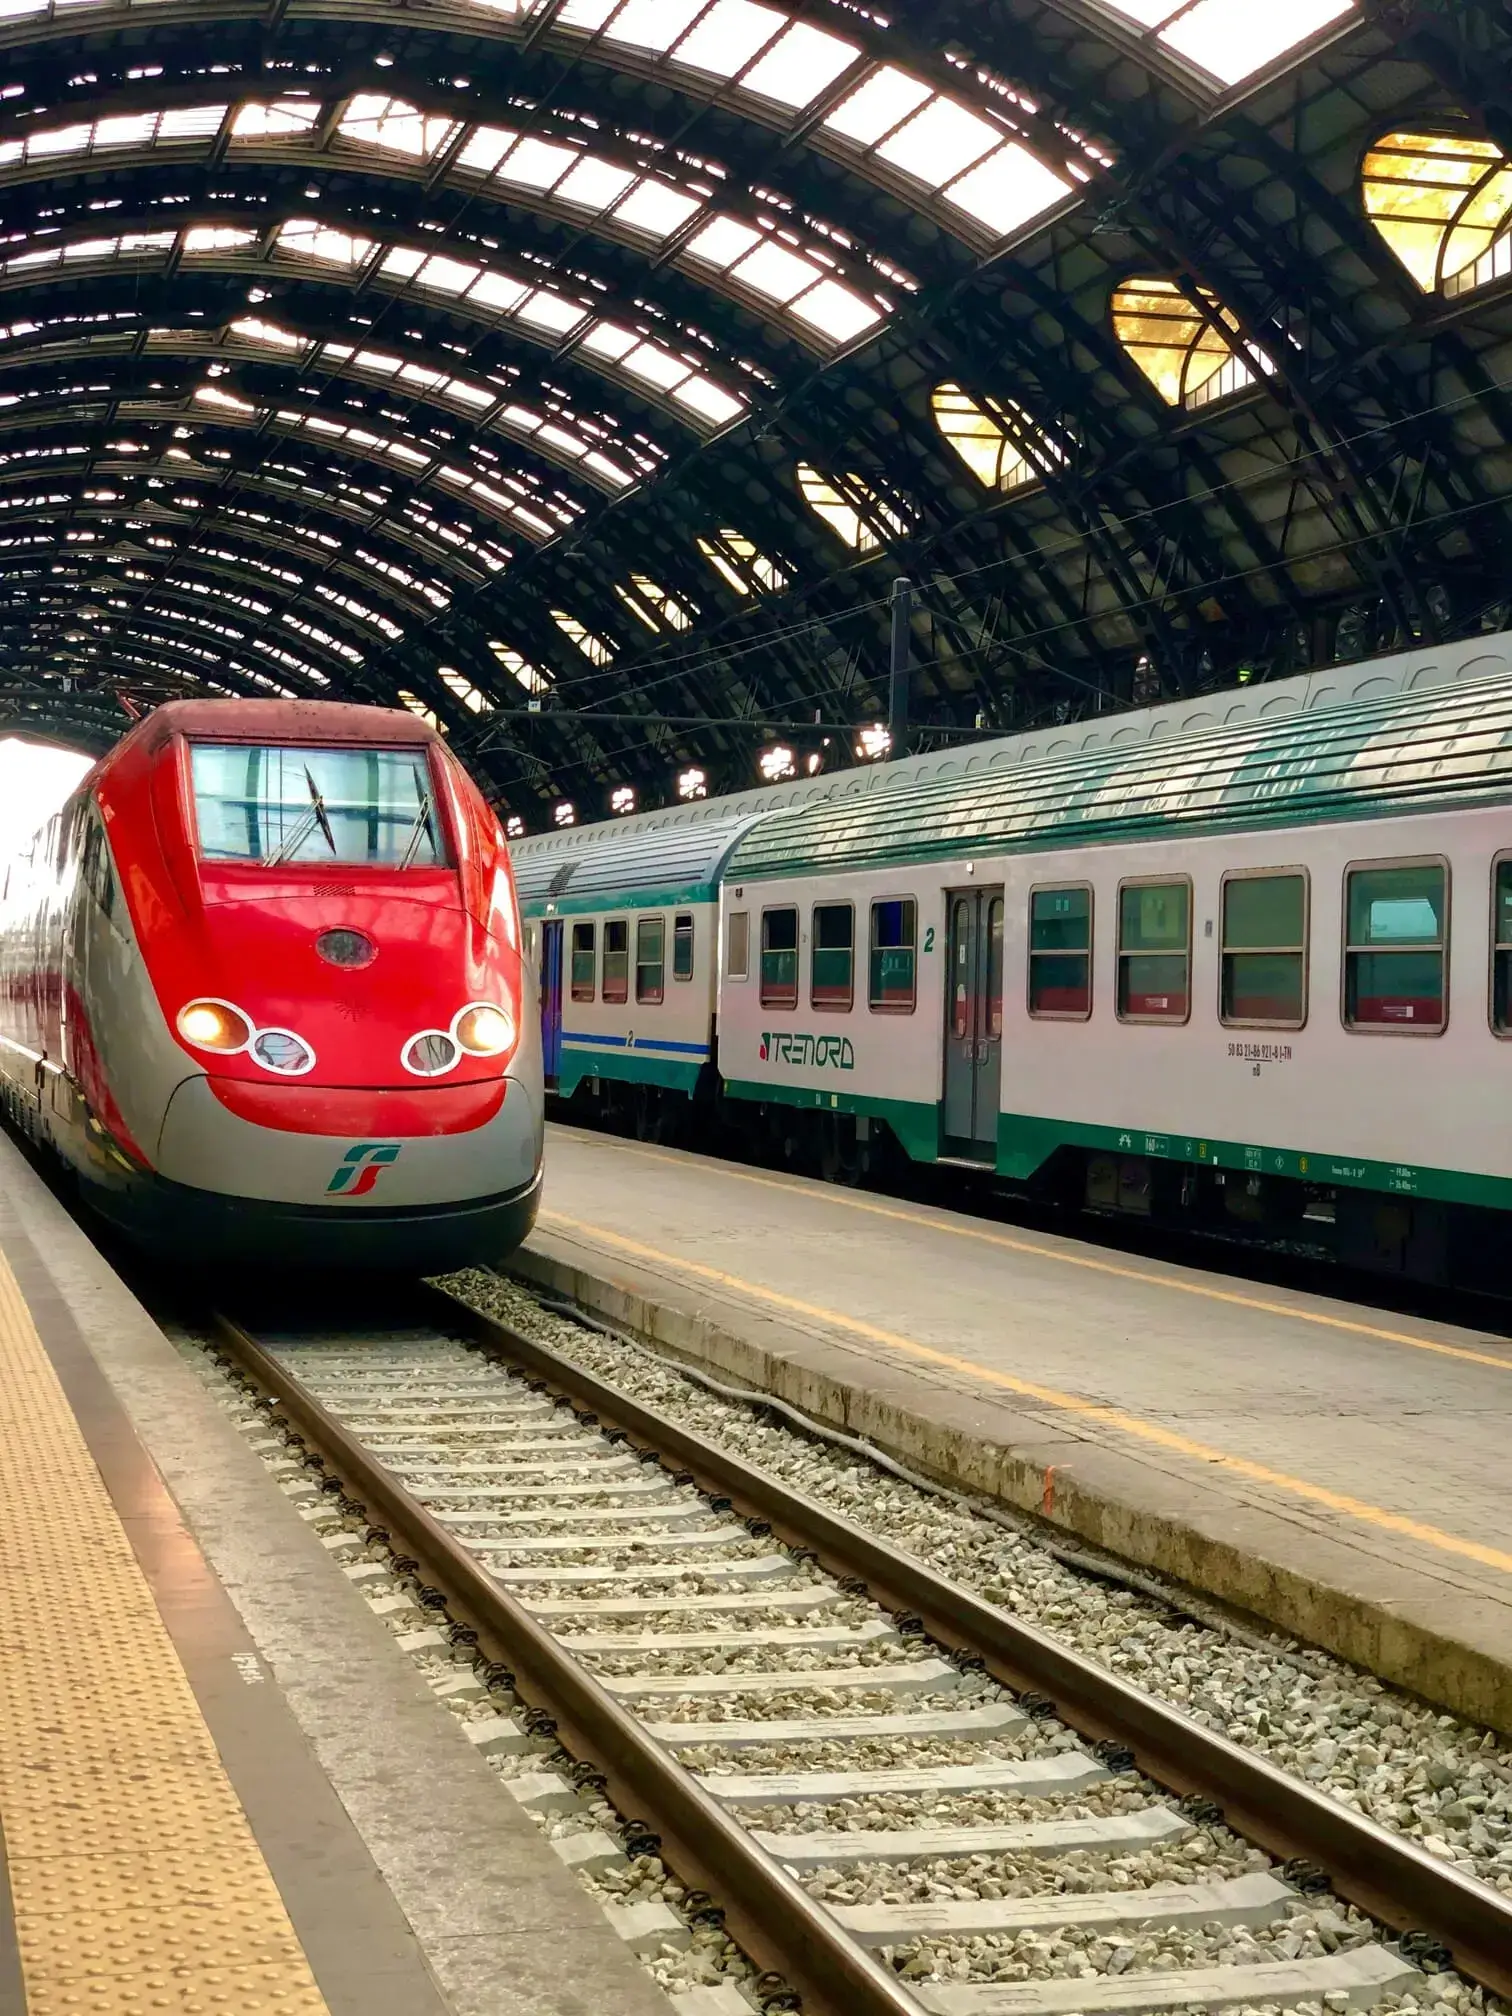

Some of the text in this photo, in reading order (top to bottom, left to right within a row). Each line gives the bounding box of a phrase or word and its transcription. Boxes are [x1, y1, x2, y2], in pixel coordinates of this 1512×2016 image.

[923, 927, 935, 953] 2
[627, 1029, 635, 1048] 2
[771, 1032, 855, 1070] TRENORD
